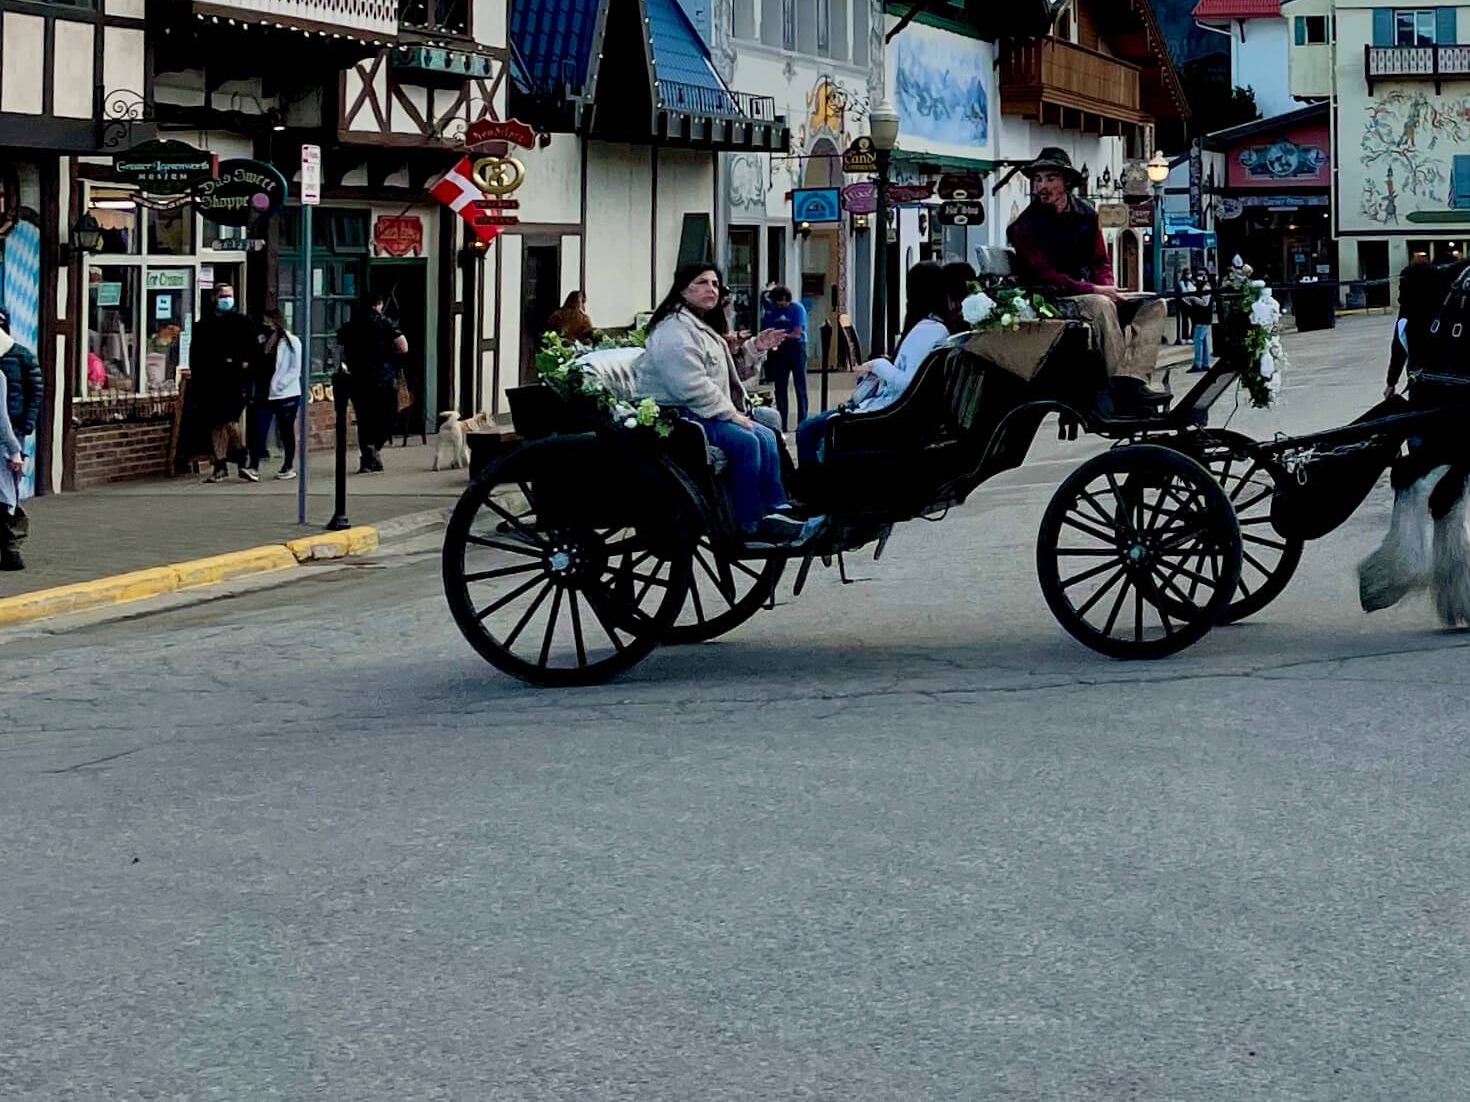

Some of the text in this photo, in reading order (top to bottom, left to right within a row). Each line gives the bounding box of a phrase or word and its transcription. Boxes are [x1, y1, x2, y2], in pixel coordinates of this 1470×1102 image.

[137, 172, 188, 180] MUSEUM
[233, 168, 278, 192] Sweet
[199, 194, 250, 211] Shoppe
